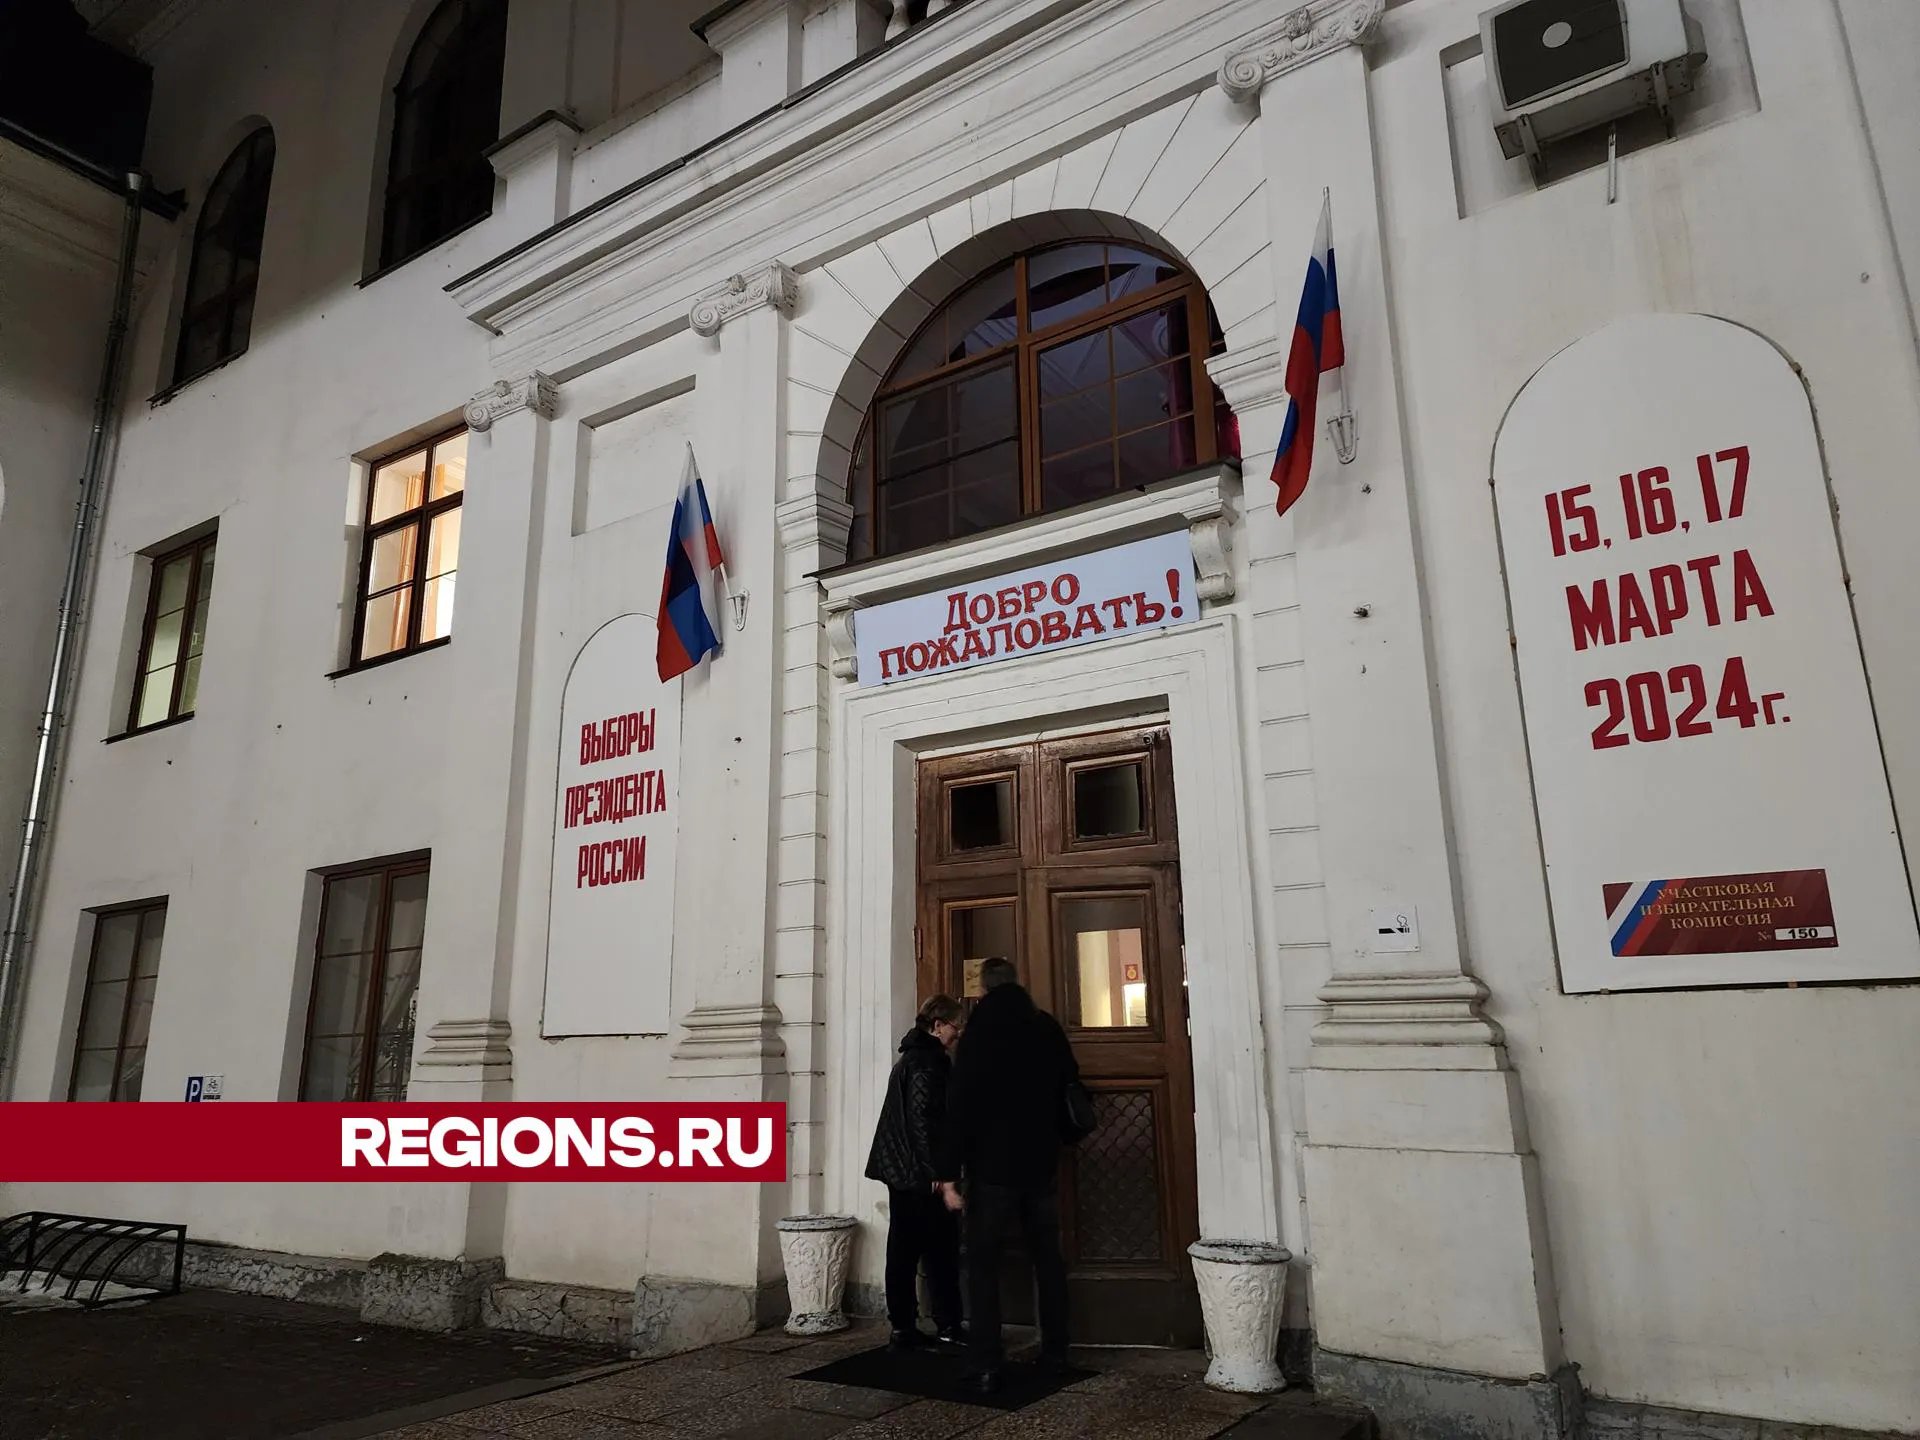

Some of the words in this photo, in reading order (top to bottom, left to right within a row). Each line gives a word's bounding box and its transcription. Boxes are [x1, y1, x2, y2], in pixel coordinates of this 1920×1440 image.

[1544, 484, 1612, 557] 15,
[1619, 466, 1690, 540] 16,
[1696, 445, 1750, 524] 17
[879, 568, 1184, 679] ПОЖАЛОВАТЬ!
[943, 573, 1080, 635] ДОБРО
[1565, 549, 1775, 651] МАРТА
[1584, 656, 1791, 750] 2024г.
[580, 708, 655, 766] ВЫБОРЫ
[564, 769, 666, 828] ПРЕЗИДЕНТА
[577, 836, 646, 889] РОССИИ
[1657, 882, 1775, 899] УЧАСТКОВАЯ
[1641, 896, 1795, 916] ИЗБИРАТЕЛЬНАЯ
[1671, 913, 1772, 930] КОМИССИЯ
[1788, 928, 1819, 939] 150
